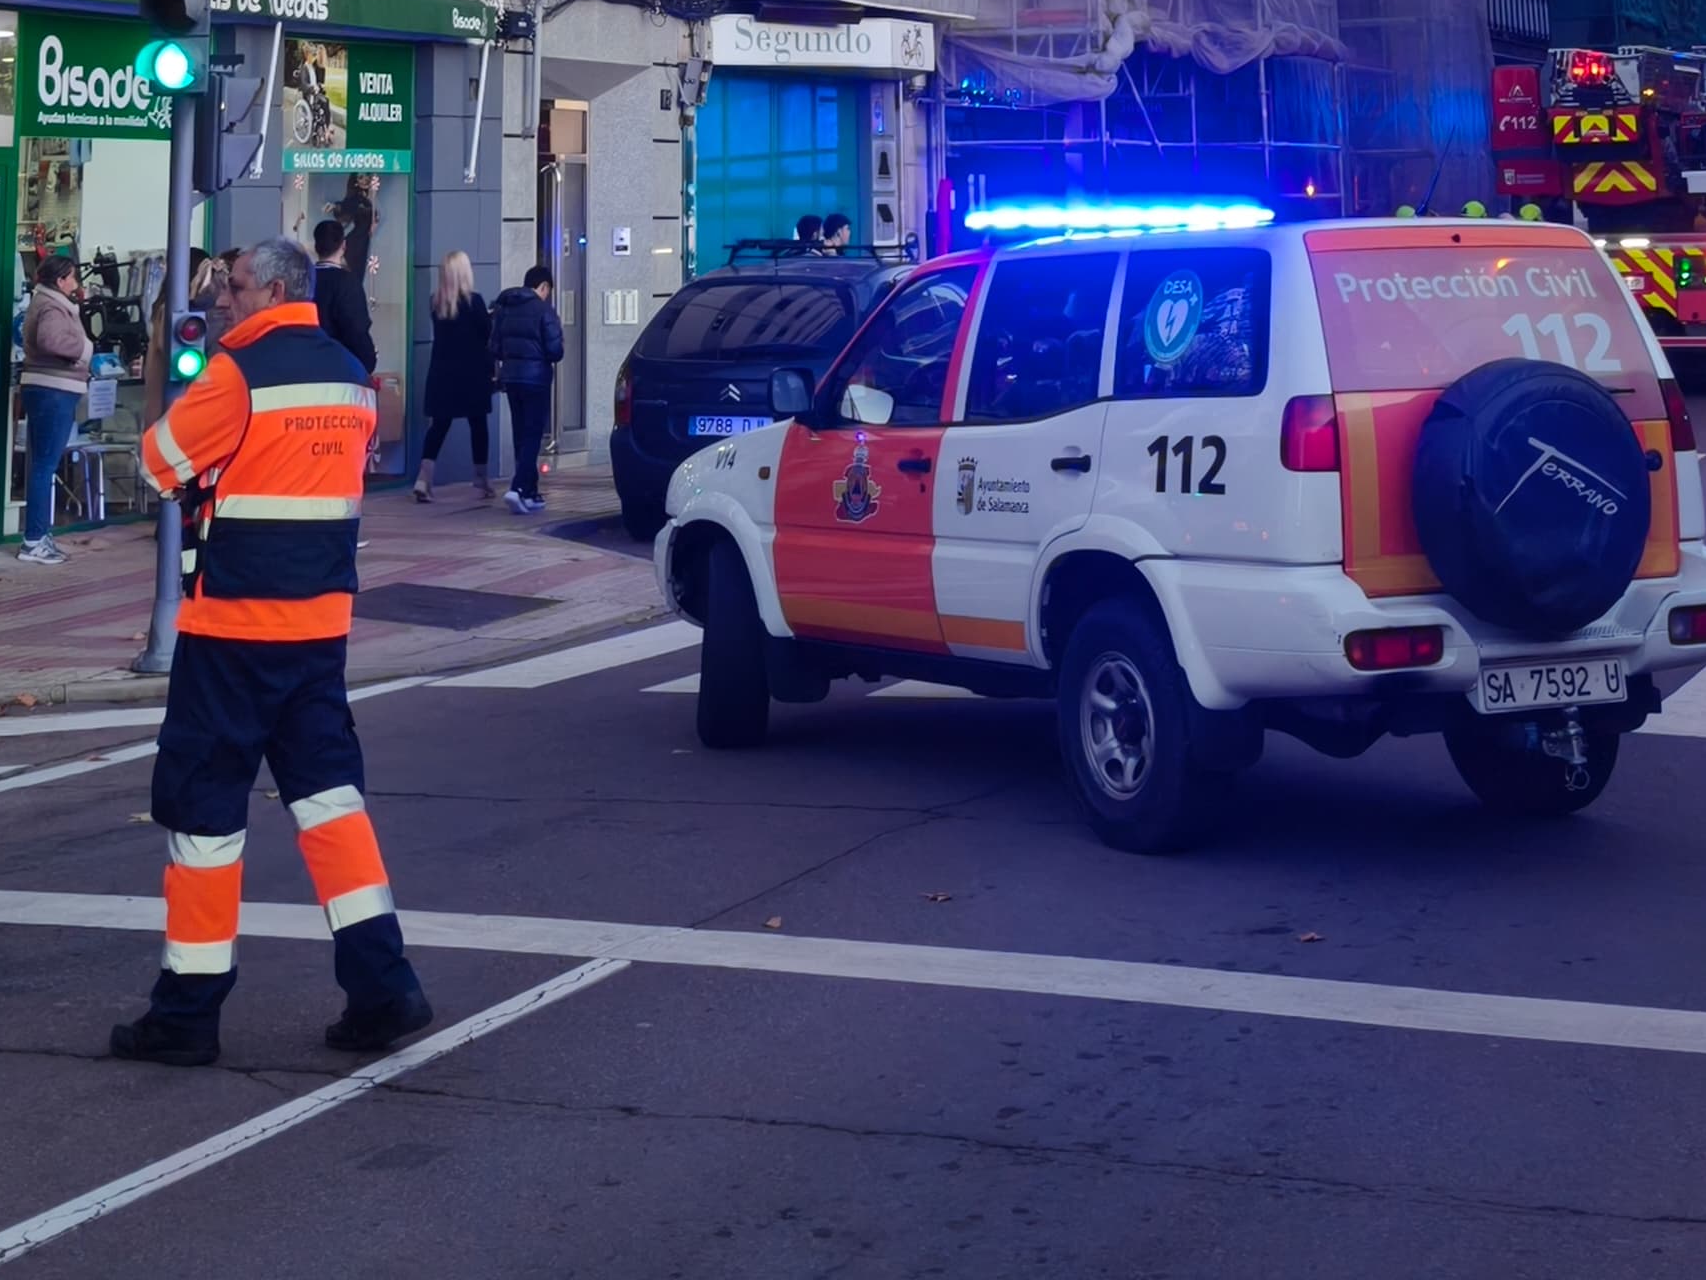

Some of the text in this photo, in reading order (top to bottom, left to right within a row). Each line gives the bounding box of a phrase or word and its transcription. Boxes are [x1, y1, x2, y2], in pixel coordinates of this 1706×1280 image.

[734, 16, 872, 64] Segundo
[38, 34, 154, 111] Bisade
[359, 71, 394, 96] VENTA
[358, 102, 403, 123] ALQUILER
[1511, 116, 1537, 130] 112
[293, 152, 385, 170] sillas de ruedas
[1163, 279, 1193, 295] DESA
[1334, 267, 1597, 303] Protección Civil
[1501, 312, 1622, 373] 112
[698, 418, 733, 433] 9788
[311, 441, 344, 456] CIVIL
[715, 449, 737, 471] V14
[1147, 434, 1227, 496] 112
[977, 476, 1031, 494] Ayuntamiento
[976, 499, 1030, 514] de Salamanca
[1487, 663, 1620, 704] SA 7592 U
